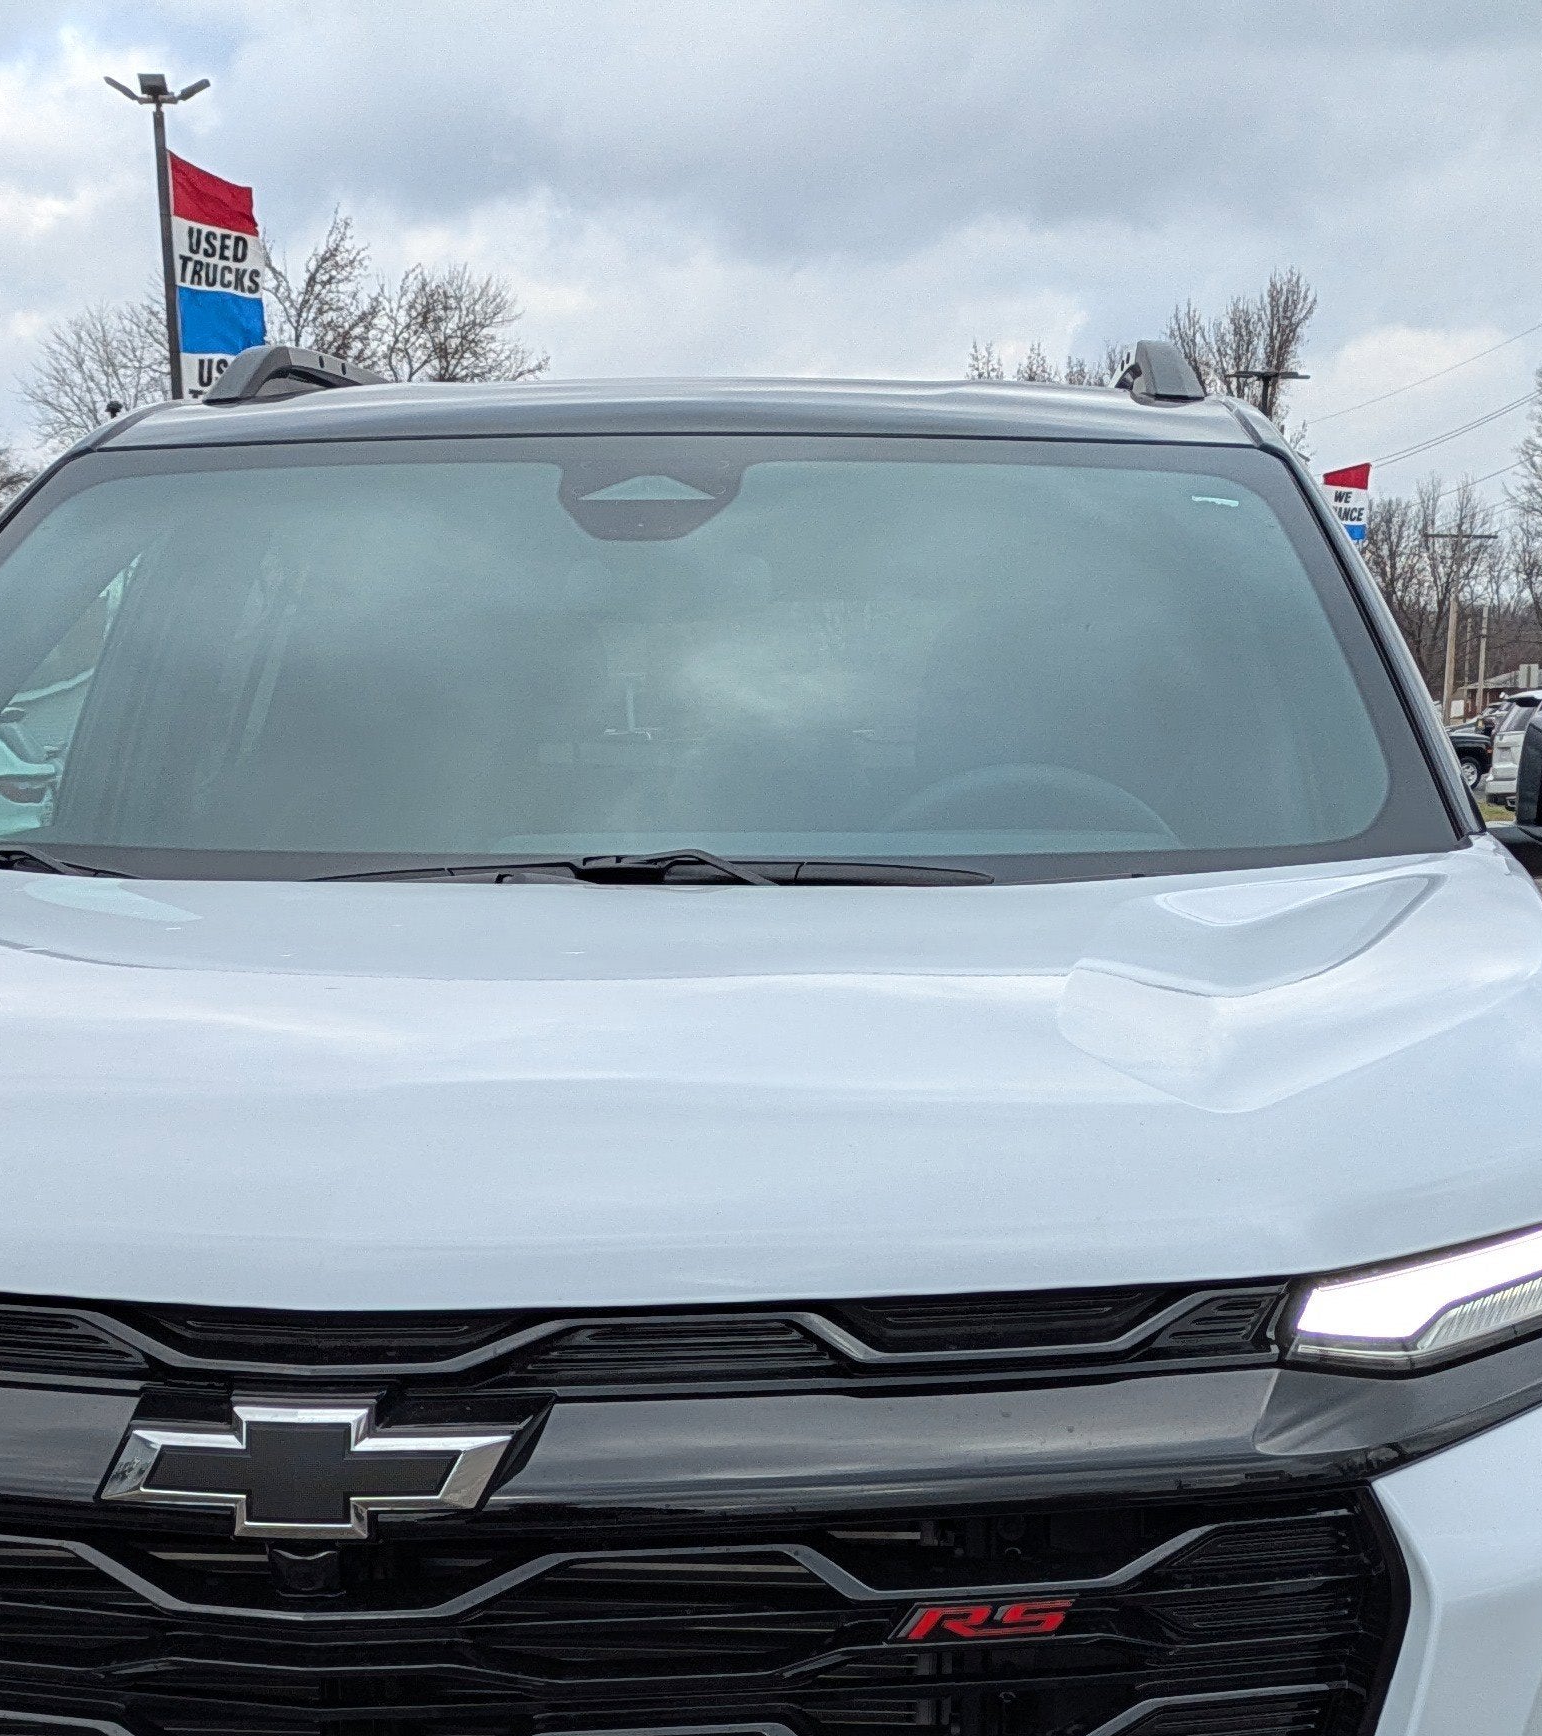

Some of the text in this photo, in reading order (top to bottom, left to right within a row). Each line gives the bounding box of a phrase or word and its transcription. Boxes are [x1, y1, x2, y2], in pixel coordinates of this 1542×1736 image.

[187, 226, 248, 263] USED
[178, 254, 260, 294] TRUCKS
[1332, 505, 1365, 522] ANCE
[1334, 490, 1353, 503] WE
[897, 1599, 1075, 1641] RS
